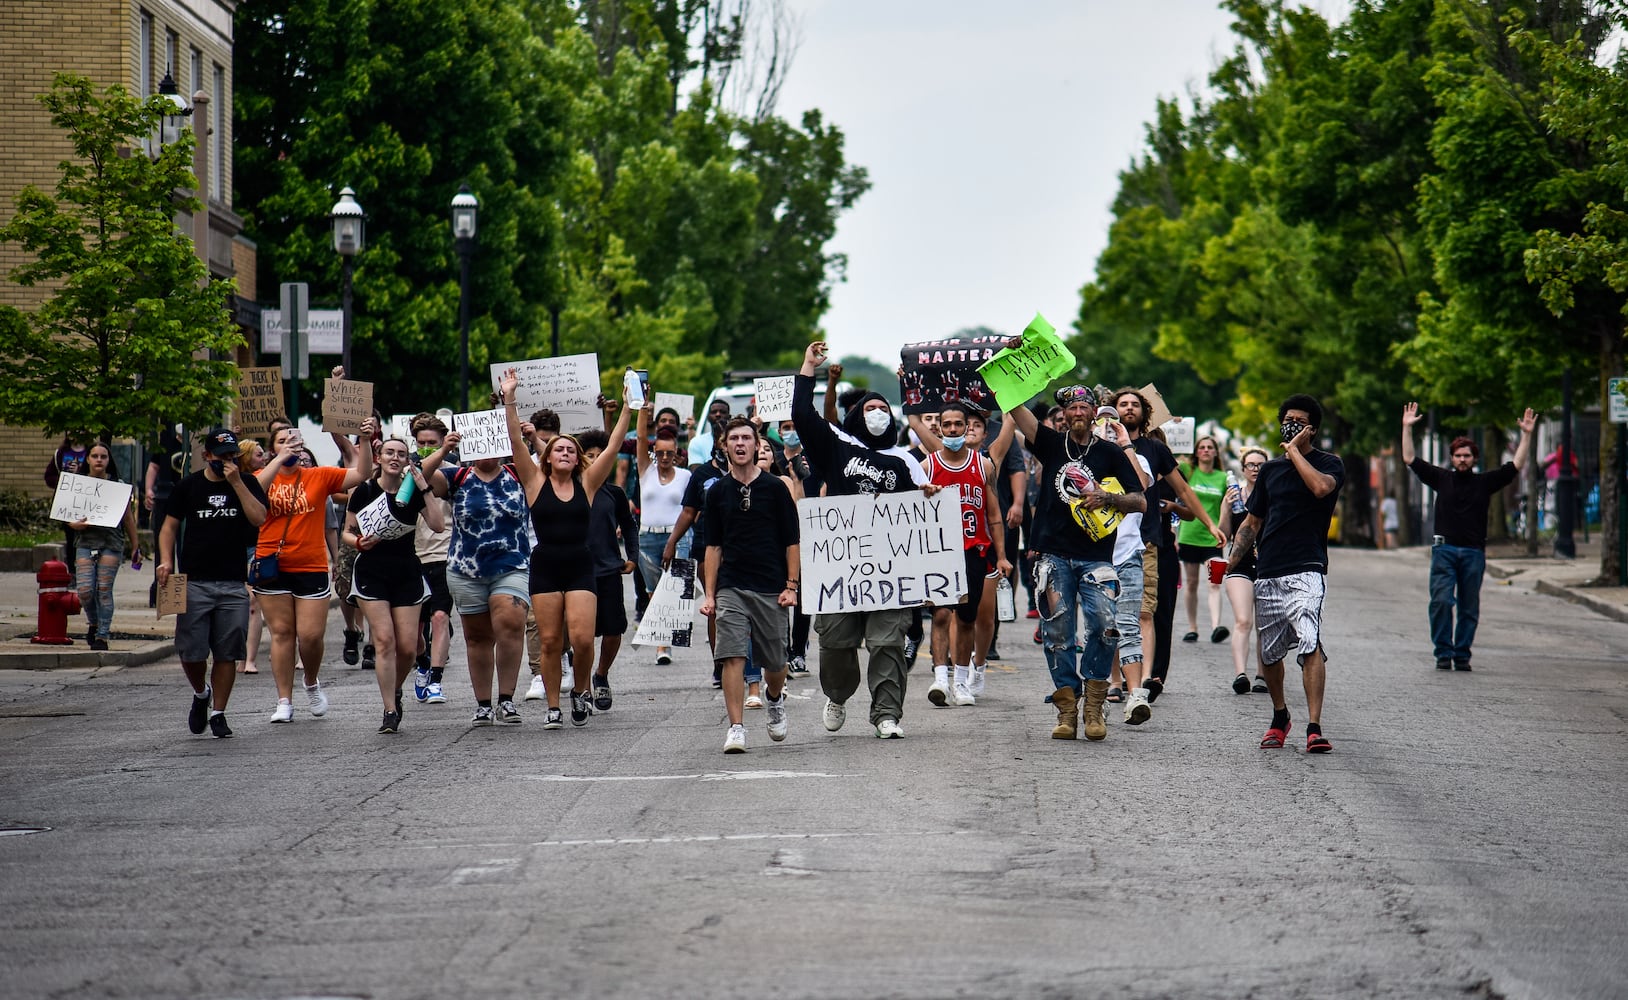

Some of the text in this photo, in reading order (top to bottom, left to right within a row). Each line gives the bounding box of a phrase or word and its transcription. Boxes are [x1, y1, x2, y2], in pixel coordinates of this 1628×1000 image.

[918, 348, 993, 364] MATTER
[757, 378, 793, 392] BLACK
[758, 389, 791, 402] LIVES
[758, 400, 792, 414] MATTE
[486, 424, 508, 436] BLAC
[844, 456, 885, 483] Midwest
[806, 500, 941, 532] HOW MANY
[887, 527, 955, 558] WILL
